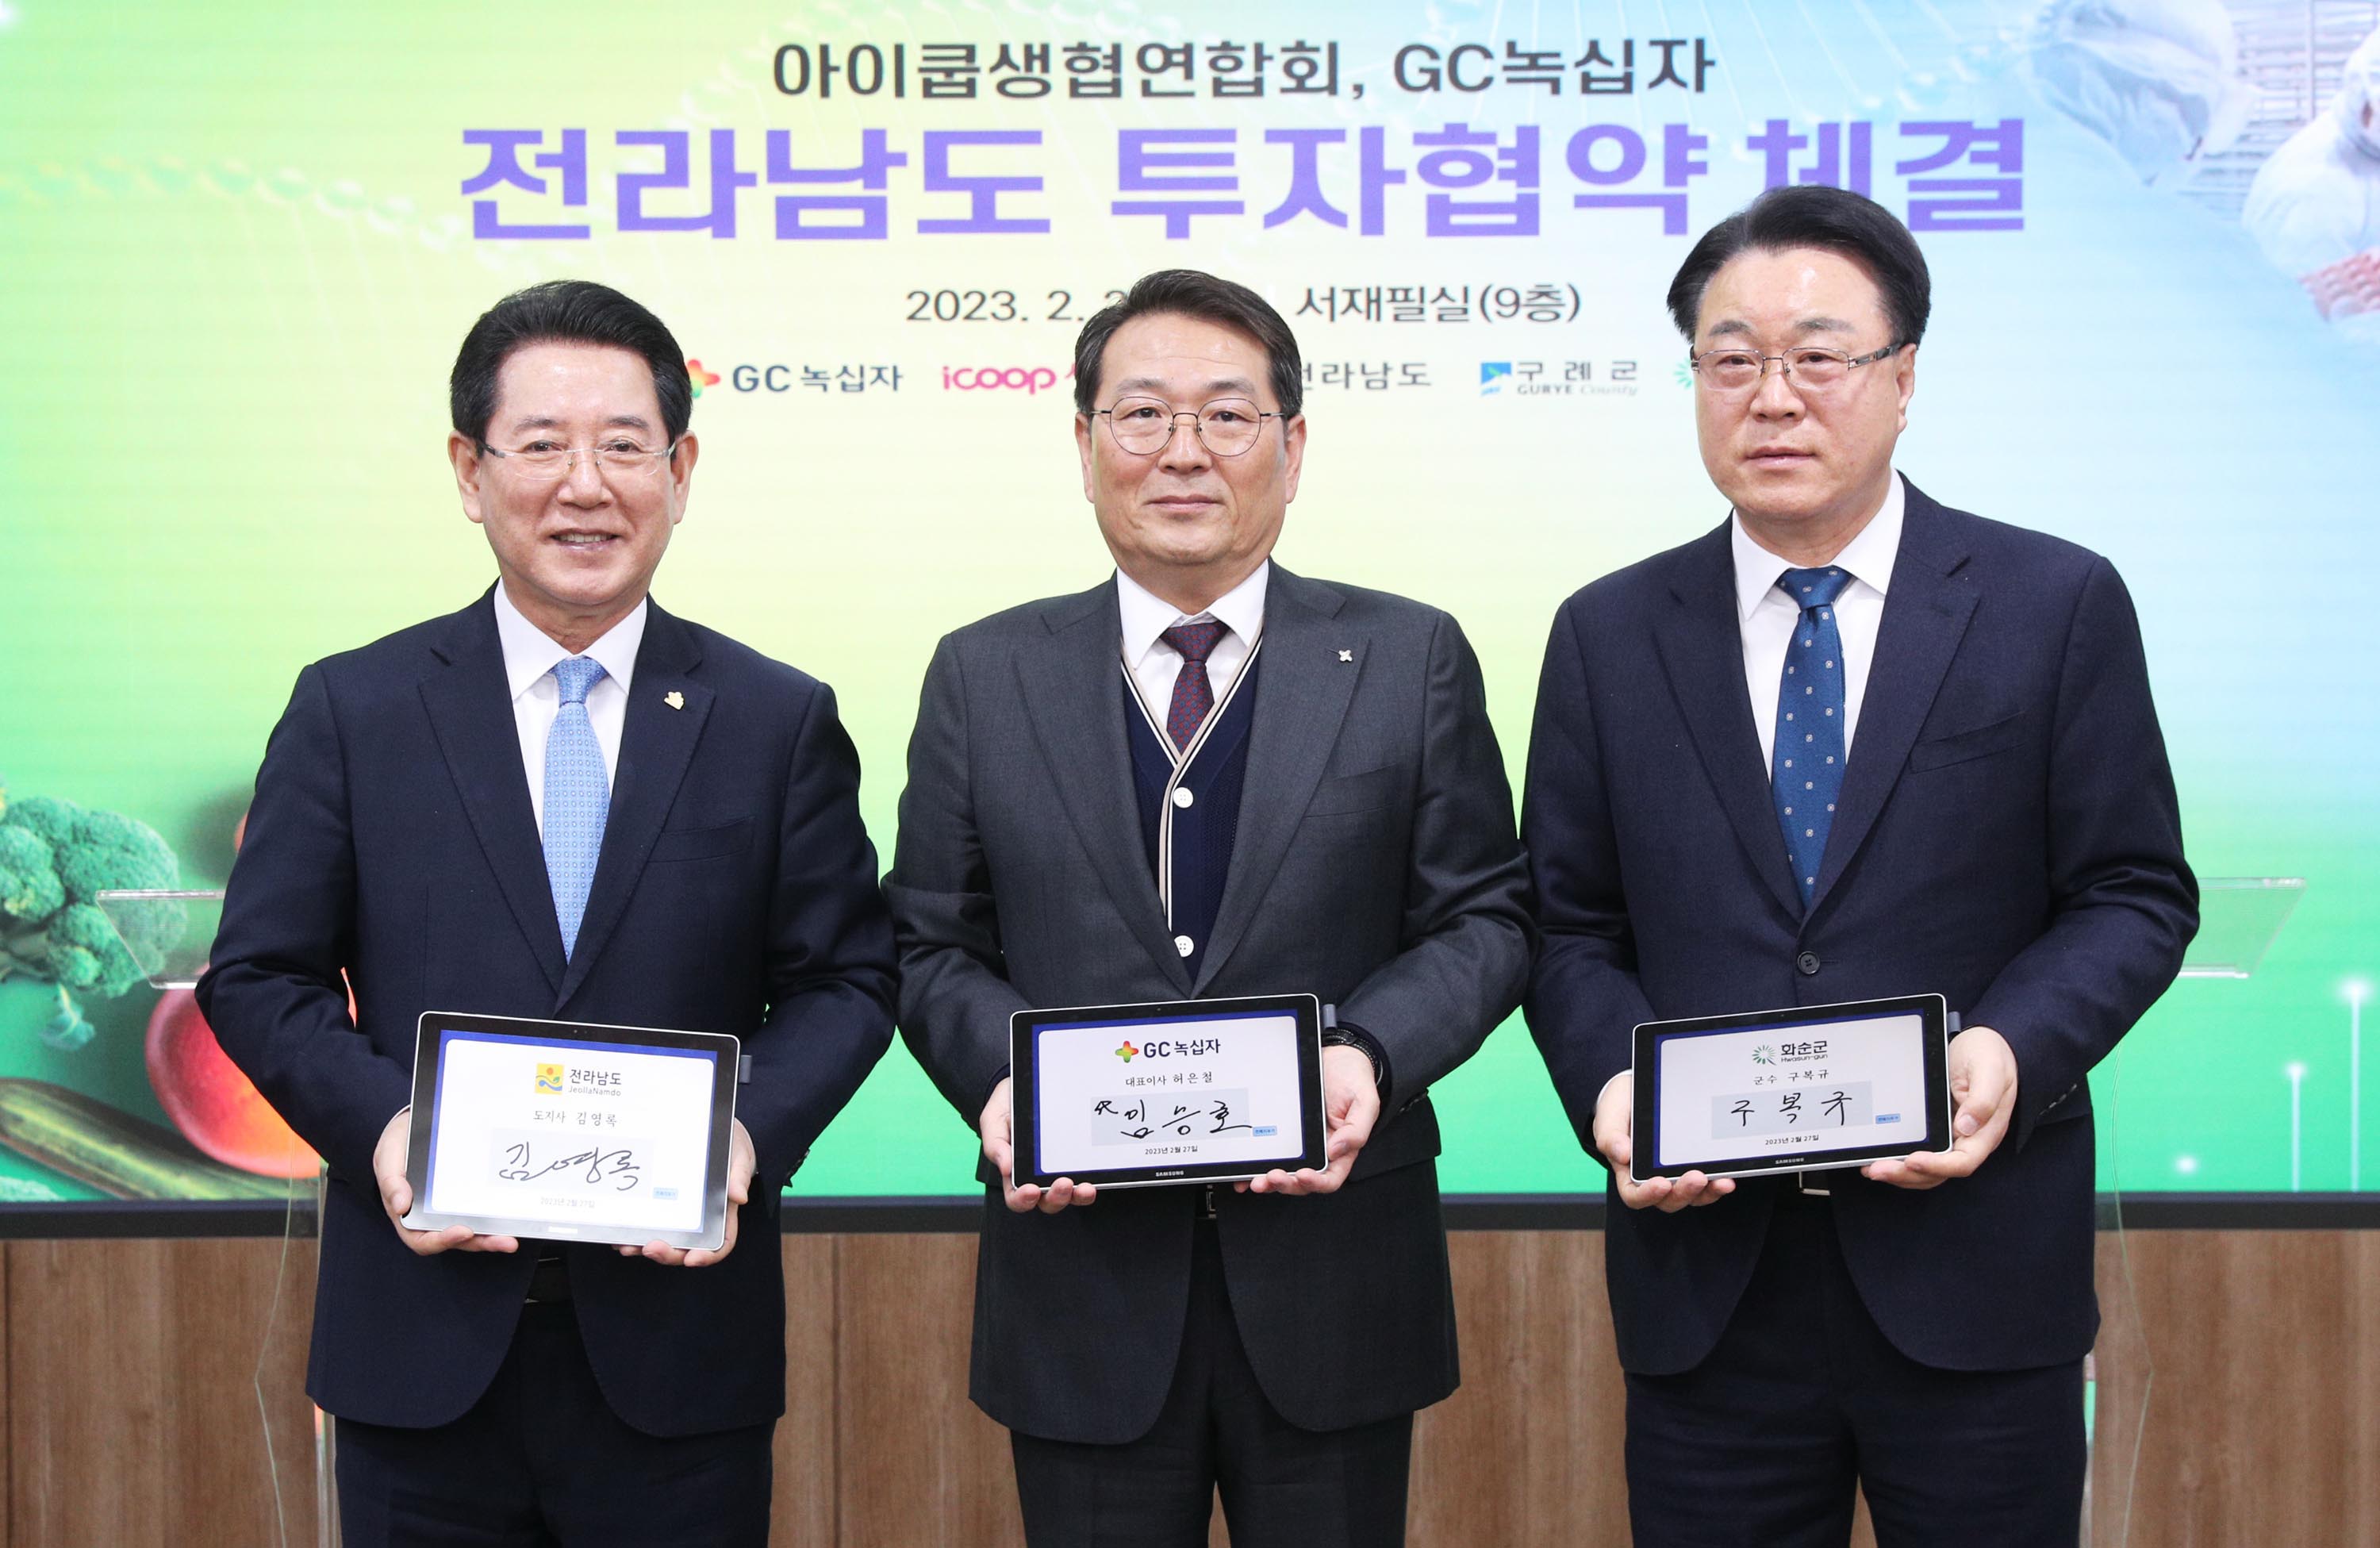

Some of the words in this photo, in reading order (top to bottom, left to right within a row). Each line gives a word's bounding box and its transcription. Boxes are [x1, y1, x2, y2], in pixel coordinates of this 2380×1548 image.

[773, 40, 1365, 100] 아이쿱생협연합회,
[1394, 39, 1716, 94] GC녹십자
[460, 127, 1052, 240] 전라남도
[1111, 122, 1709, 240] 투자협약
[1747, 118, 2025, 232] 체결
[906, 290, 1028, 321] 2023.
[1046, 290, 1084, 321] 2.
[1296, 283, 1580, 324] 서재필실(9층)
[732, 364, 790, 392] GC
[800, 364, 904, 393] 녹십자
[942, 365, 1056, 395] icoop
[1143, 1042, 1171, 1058] GC
[1174, 1039, 1221, 1056] 녹십자
[1781, 1040, 1828, 1056] 화순군
[1781, 1054, 1828, 1062] Hwasun-gun
[570, 1069, 622, 1086] 전라남도
[1125, 1075, 1167, 1088] 대표이사
[1173, 1071, 1213, 1085] 허은철
[1754, 1074, 1778, 1085] 군수
[1787, 1069, 1829, 1082] 구복규
[569, 1085, 621, 1097] JeollaNamdo
[533, 1110, 566, 1124] 도지사
[577, 1112, 617, 1127] 김영록
